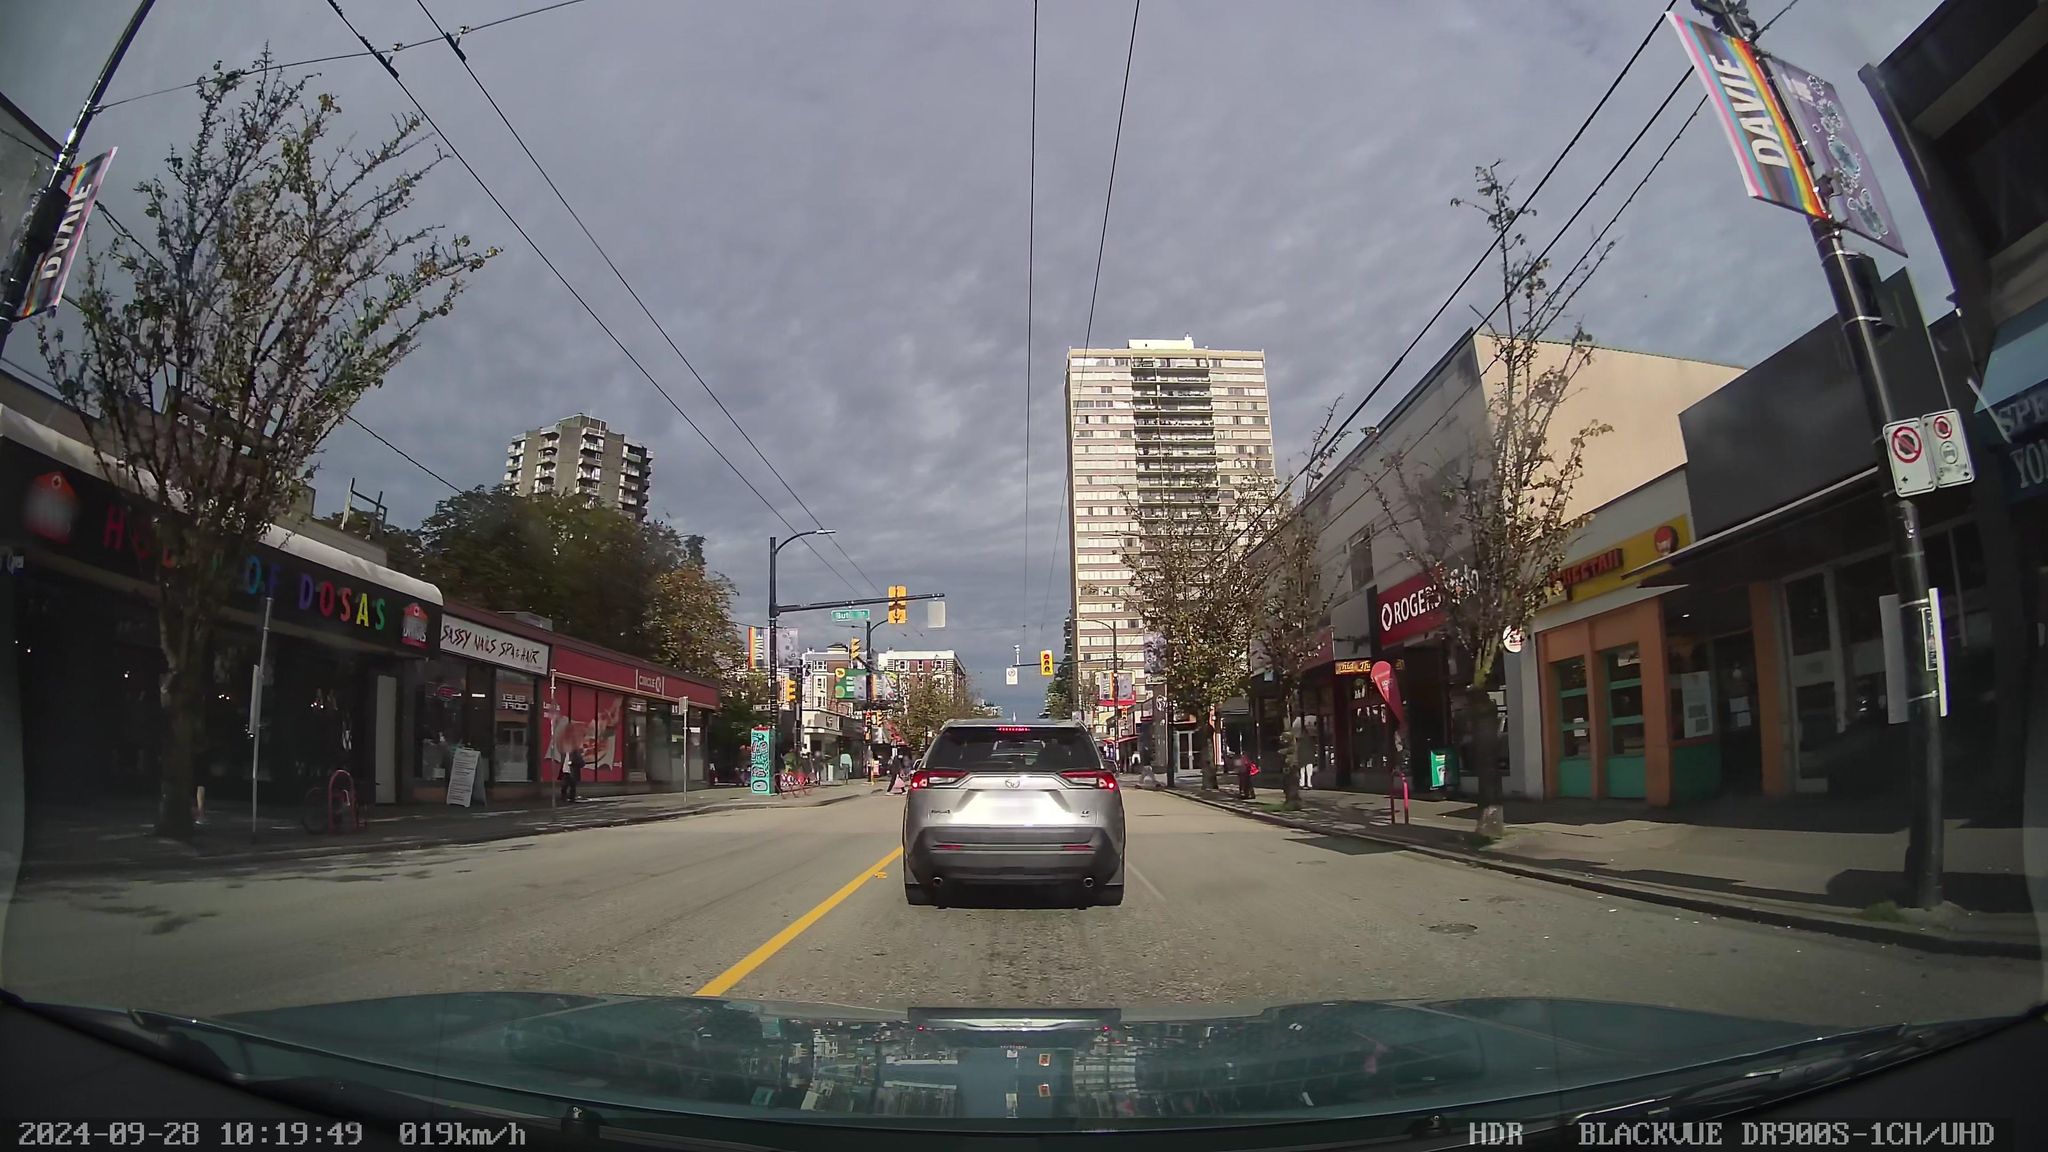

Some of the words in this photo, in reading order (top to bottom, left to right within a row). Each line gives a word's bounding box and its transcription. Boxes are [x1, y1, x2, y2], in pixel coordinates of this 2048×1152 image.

[1709, 55, 1790, 168] DAVIE
[41, 184, 92, 280] DAVIE
[297, 573, 387, 631] DOSAS
[440, 625, 472, 649] SASSY
